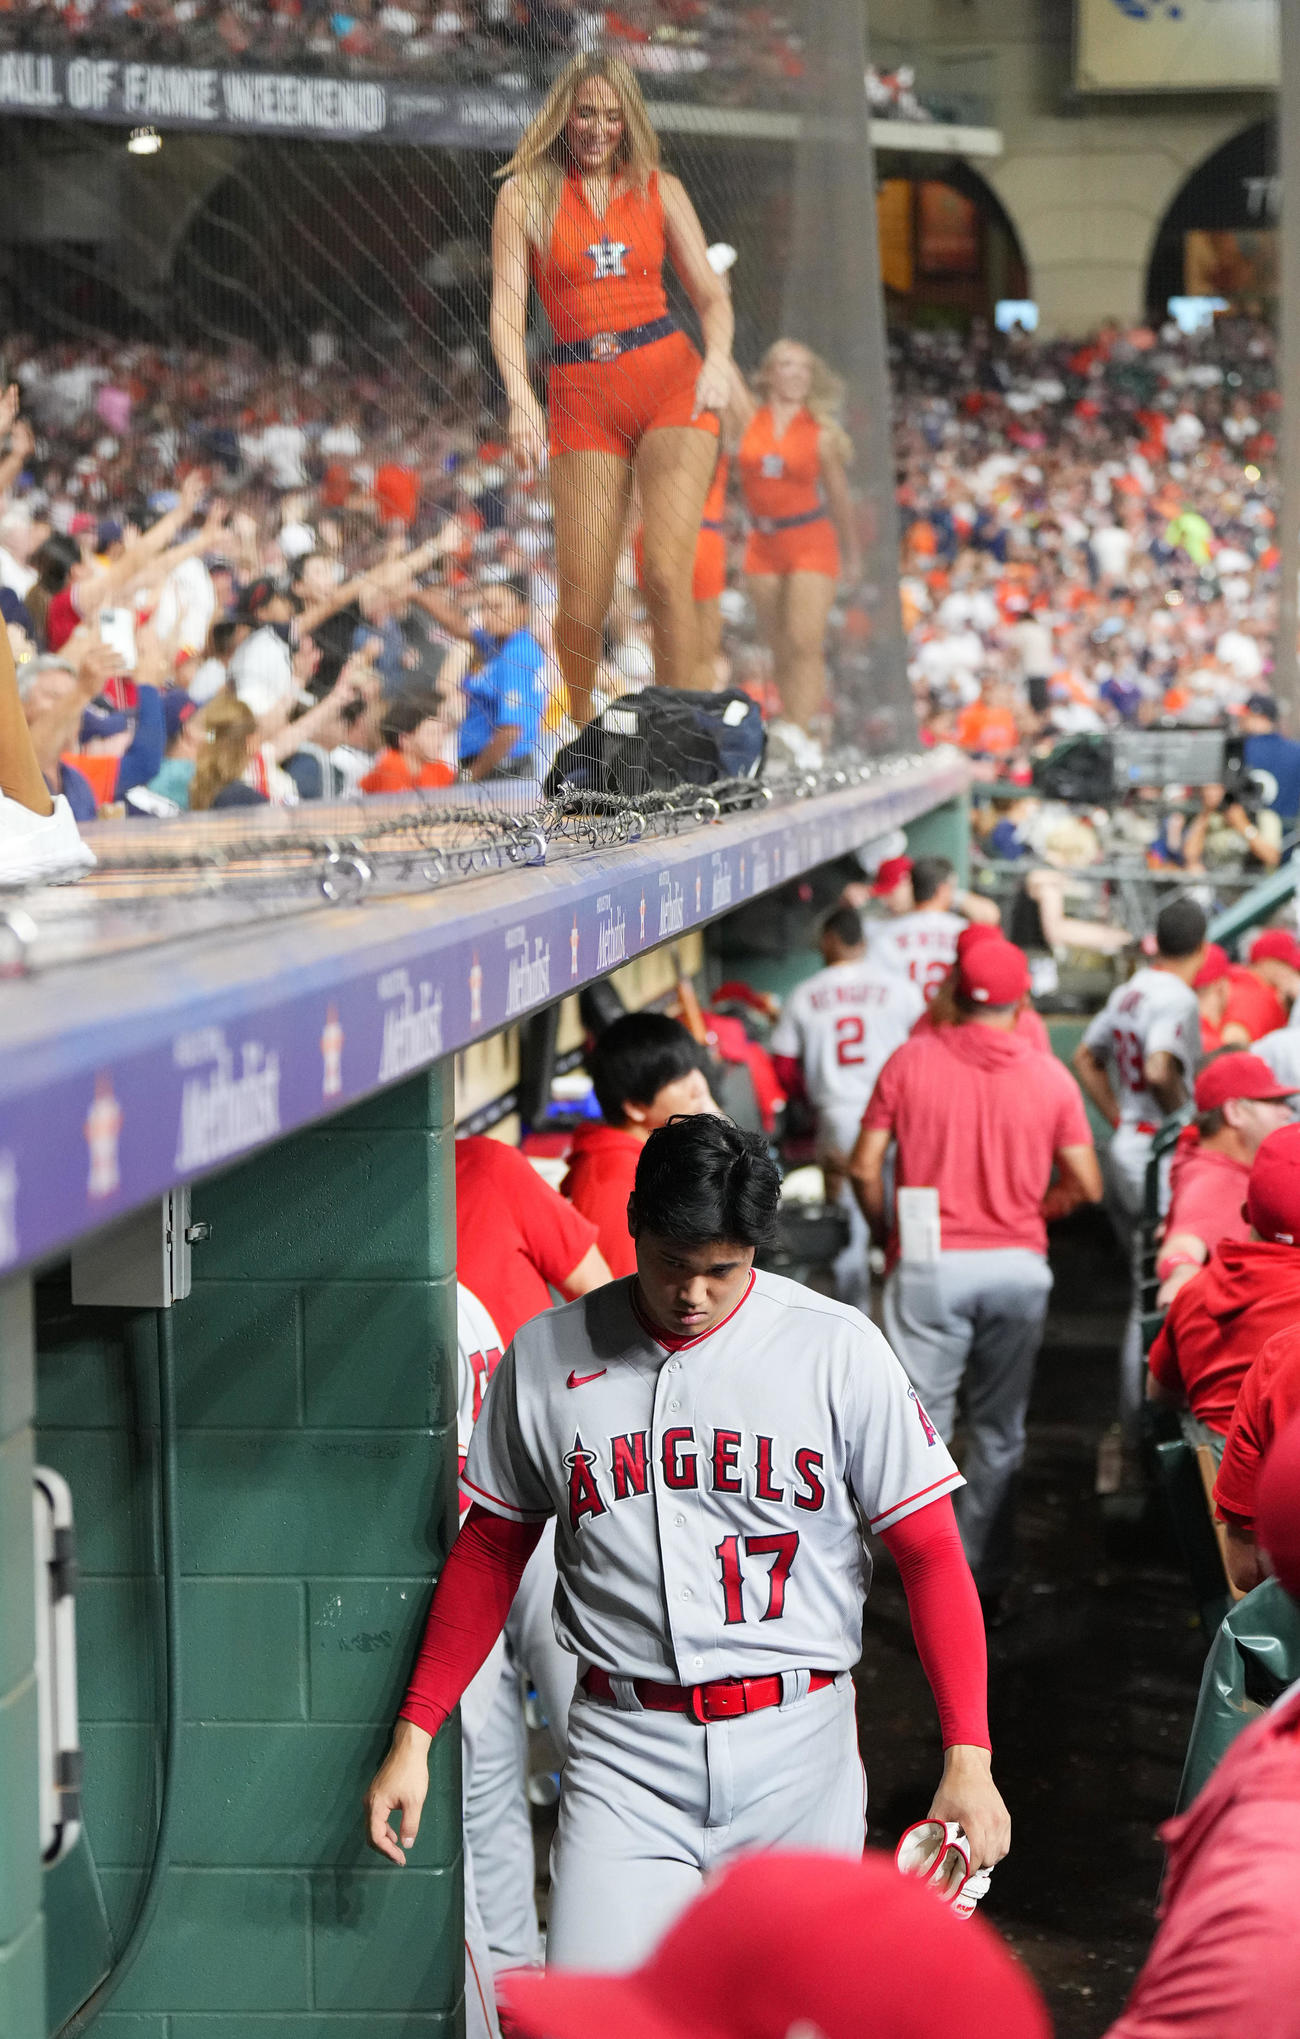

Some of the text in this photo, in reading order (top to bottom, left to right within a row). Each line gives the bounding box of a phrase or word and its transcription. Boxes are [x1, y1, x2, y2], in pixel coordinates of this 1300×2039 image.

[67, 57, 118, 111] OF
[124, 62, 218, 121] FAME
[222, 72, 386, 133] WEEKEND
[596, 904, 627, 970] Methodist
[836, 1016, 865, 1066] 2
[563, 1425, 825, 1534] ANGELS
[715, 1530, 799, 1626] 17
